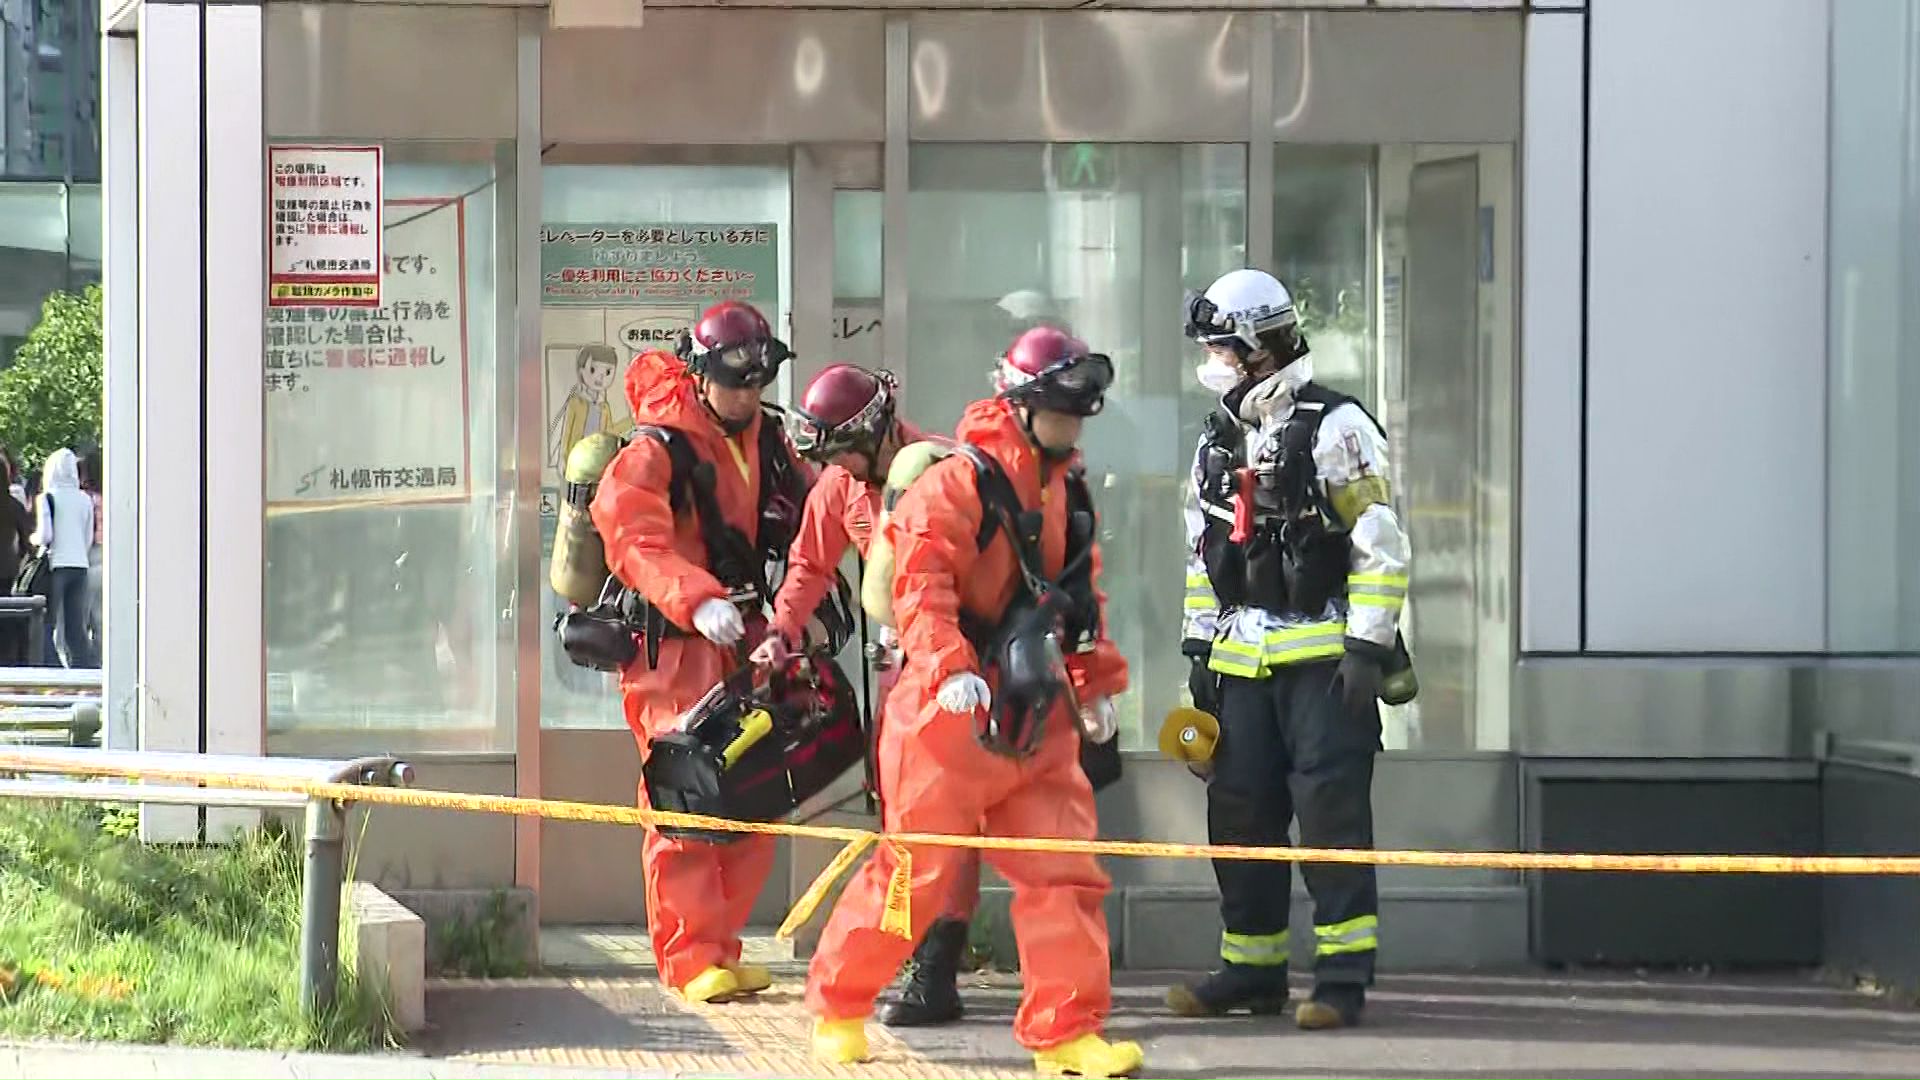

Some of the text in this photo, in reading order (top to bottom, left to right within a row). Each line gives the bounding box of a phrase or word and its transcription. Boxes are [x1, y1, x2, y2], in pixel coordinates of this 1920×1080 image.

[330, 467, 457, 490] 札幌市交通局
